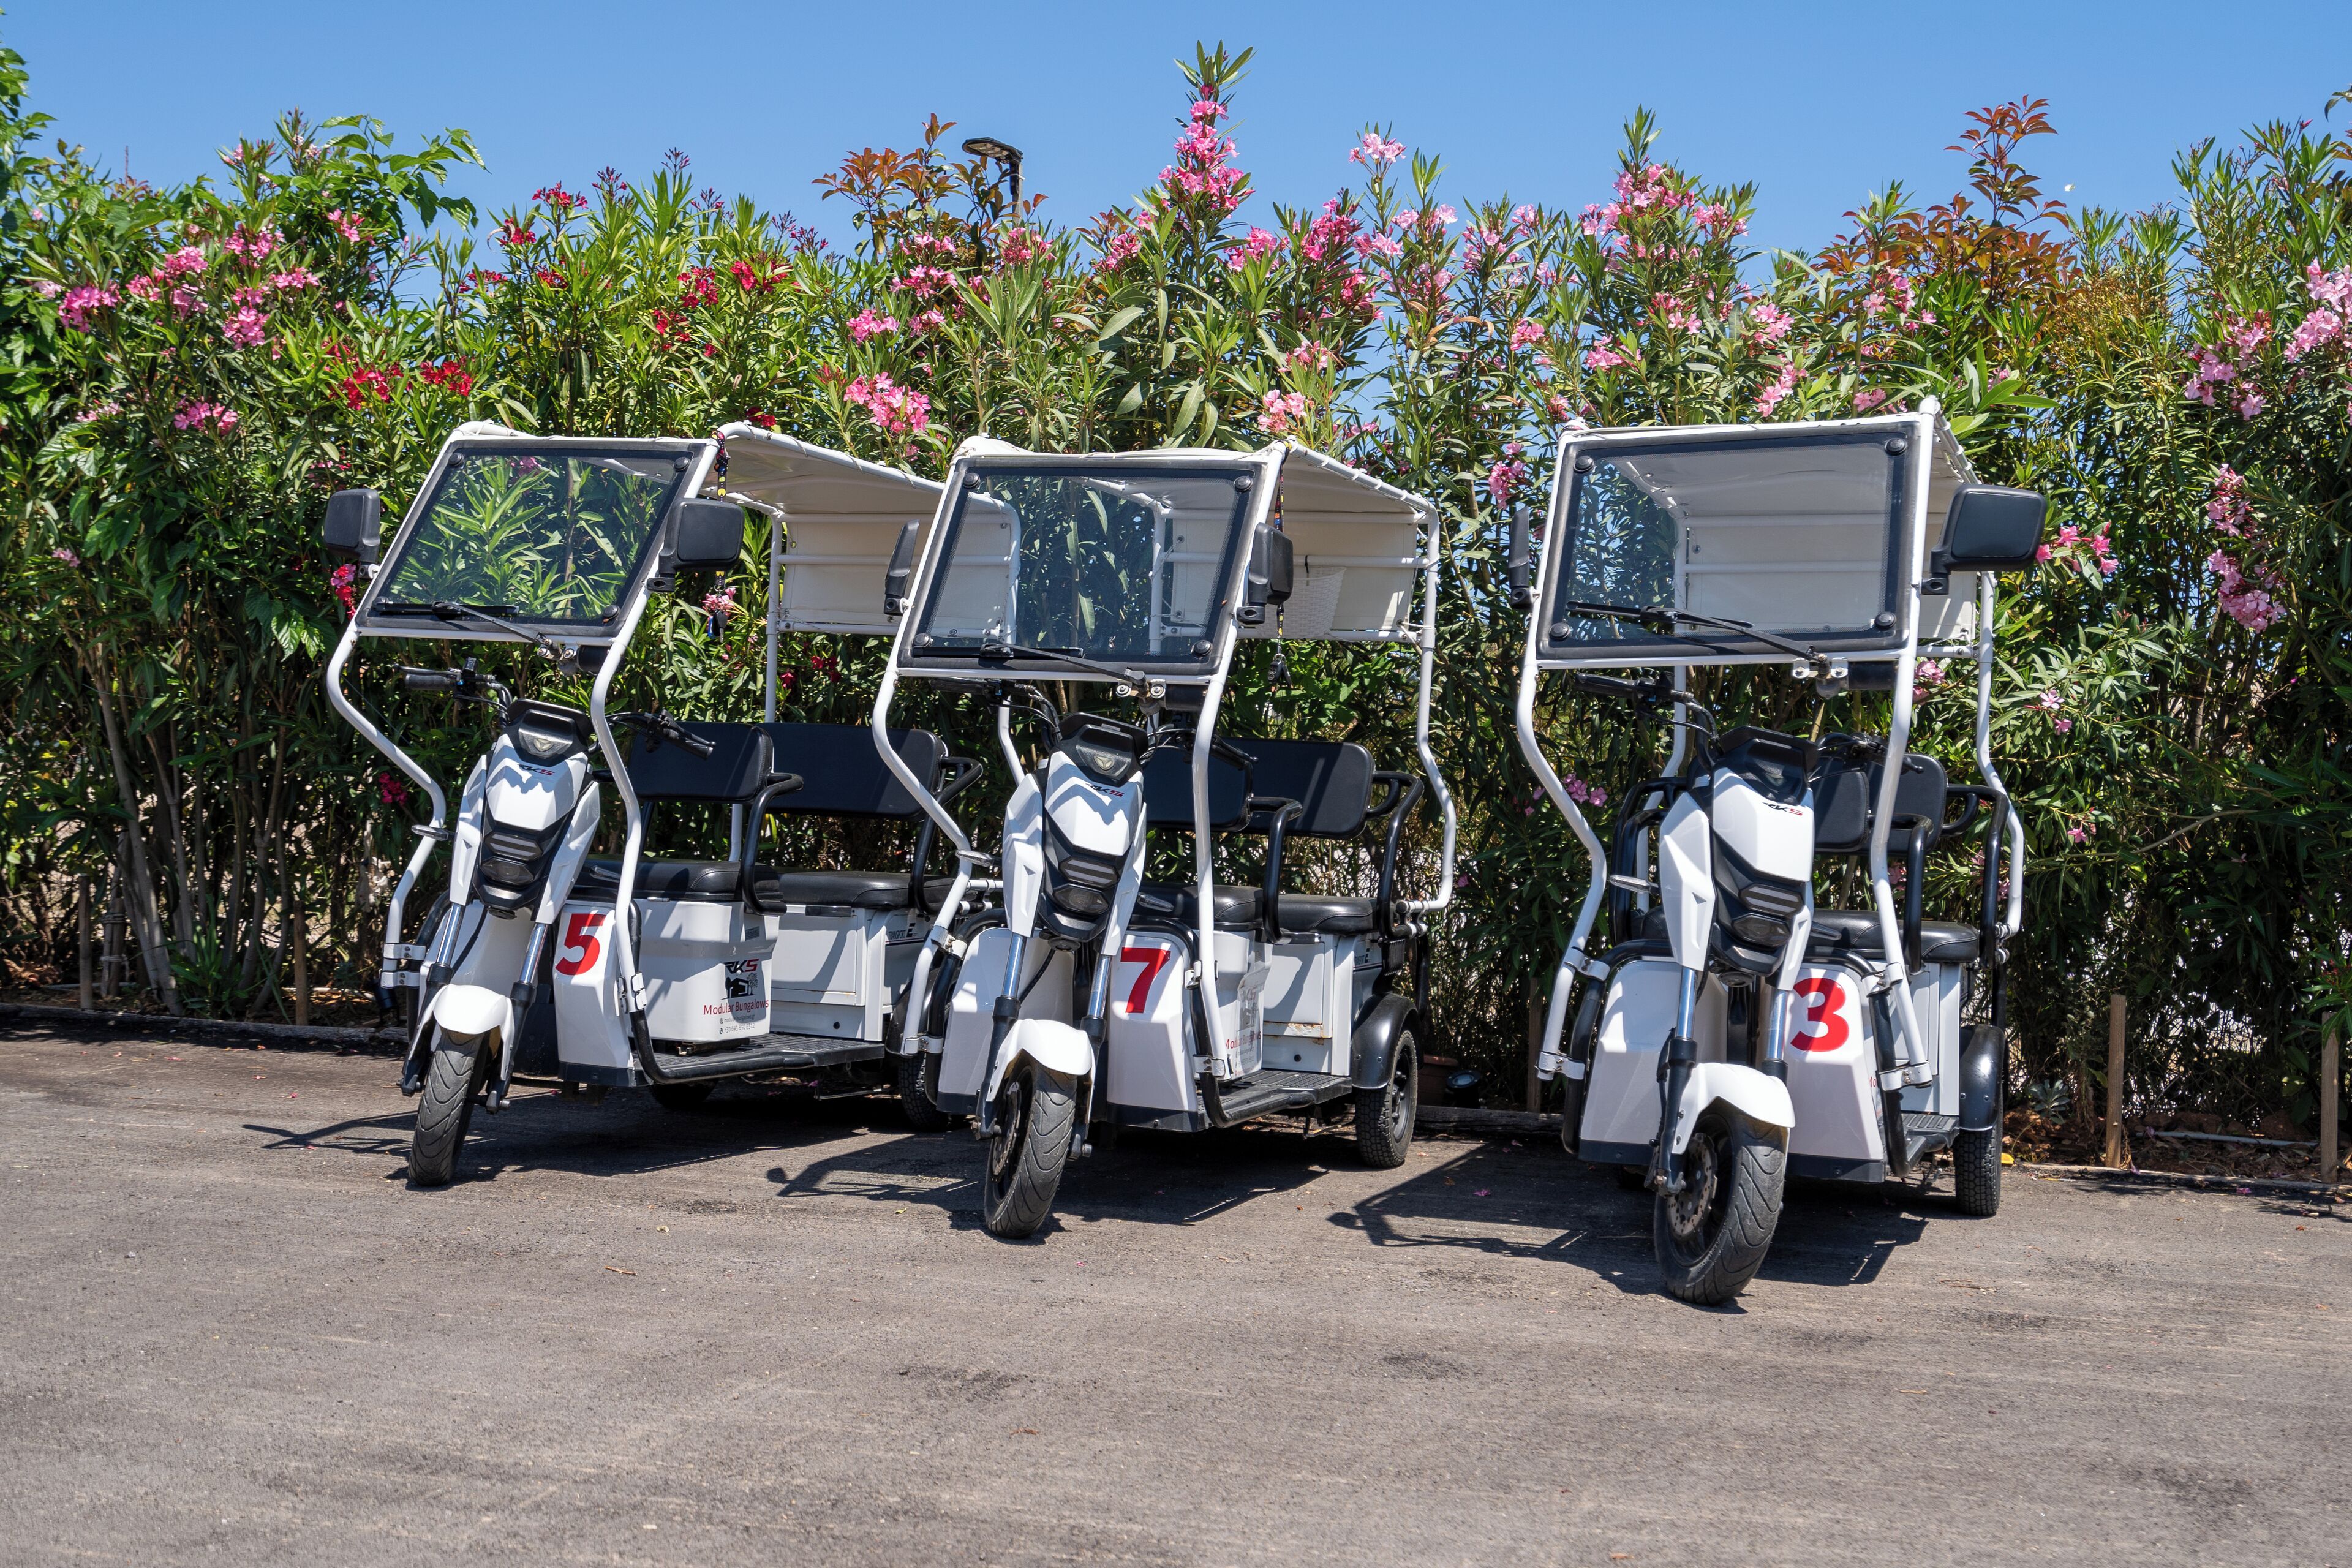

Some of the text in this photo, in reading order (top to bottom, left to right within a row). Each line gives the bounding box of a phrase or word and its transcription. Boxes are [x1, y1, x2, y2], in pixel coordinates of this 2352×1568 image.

[555, 913, 607, 976] 5
[723, 959, 760, 974] RKS
[703, 999, 769, 1015] Modular Bungalows
[1120, 946, 1171, 1014] 7
[1790, 978, 1850, 1053] 3
